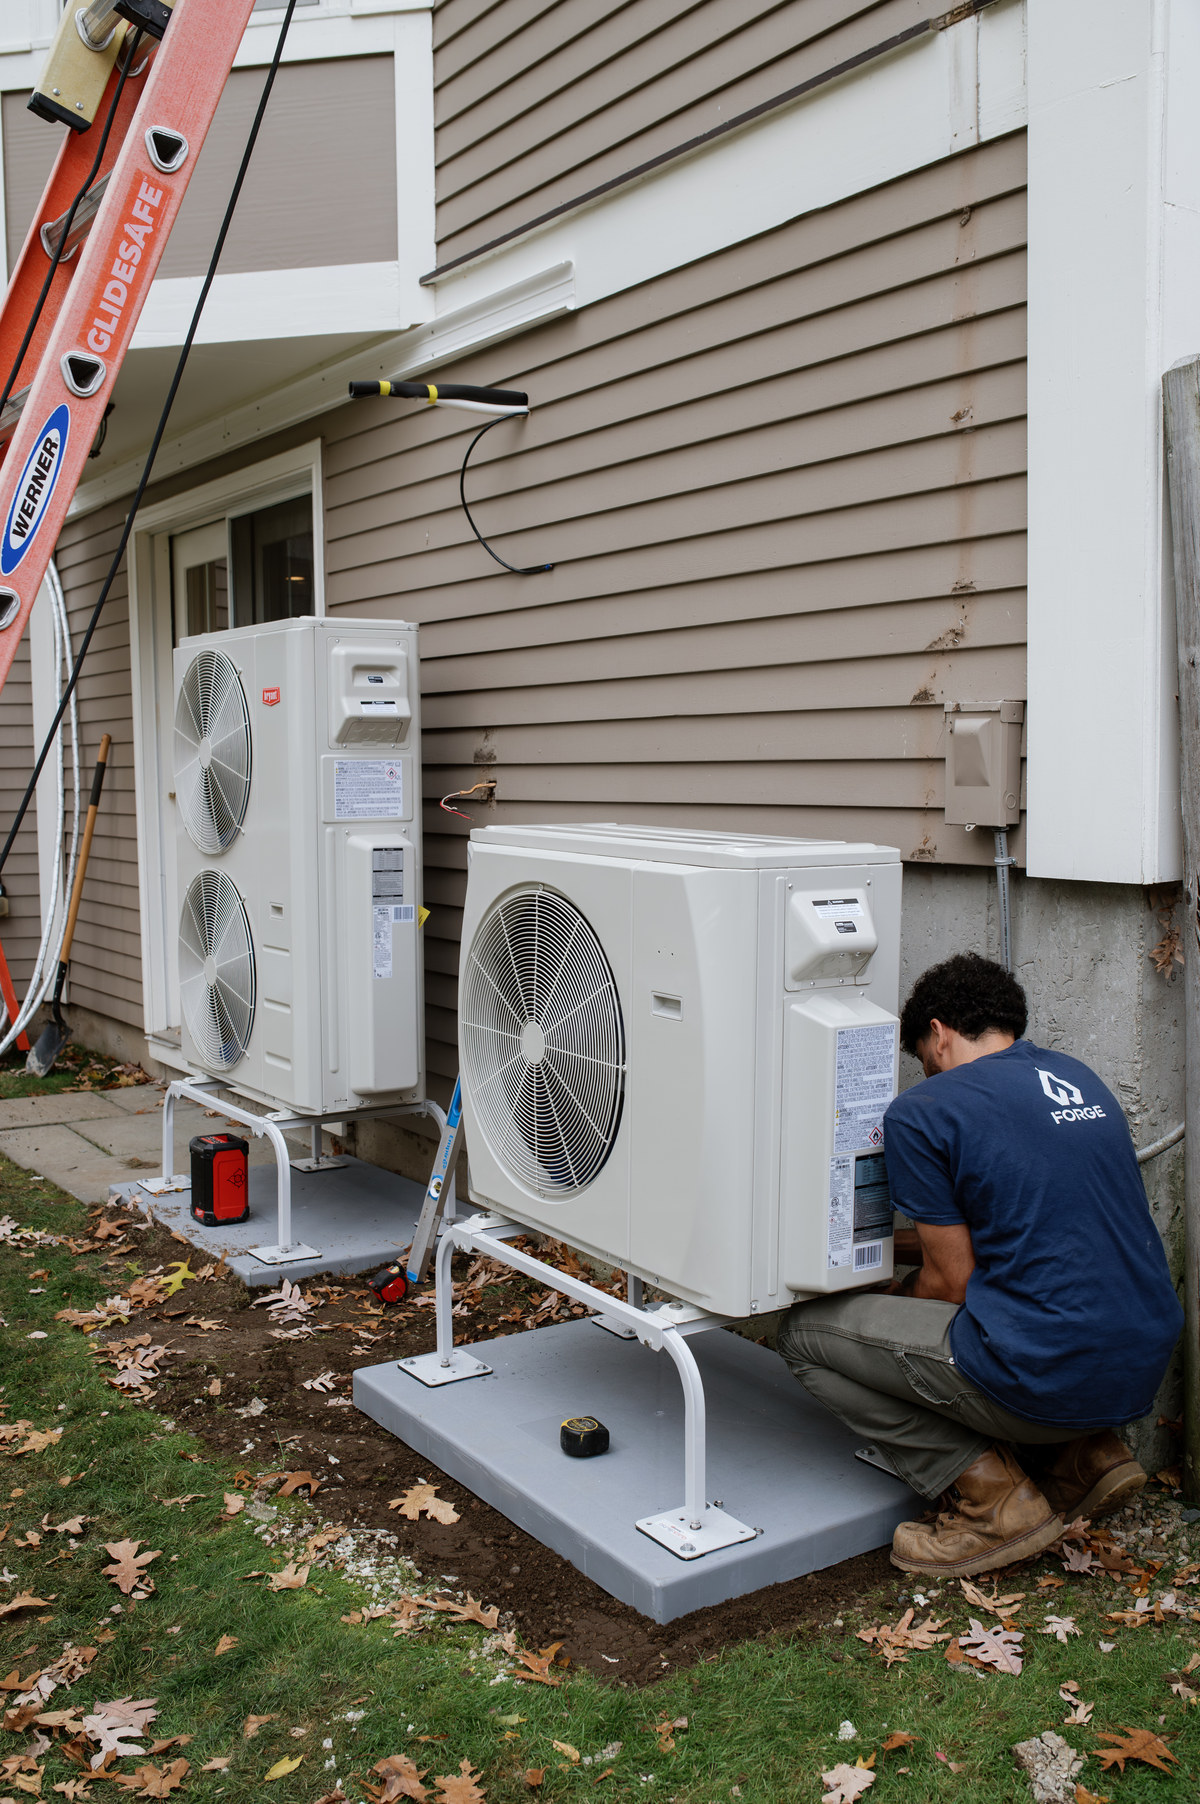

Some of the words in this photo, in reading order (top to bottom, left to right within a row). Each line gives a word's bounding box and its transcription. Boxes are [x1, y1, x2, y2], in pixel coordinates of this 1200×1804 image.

[87, 181, 163, 353] GLIDESAFE
[12, 436, 59, 539] WERNER
[1050, 1105, 1107, 1125] FORGE
